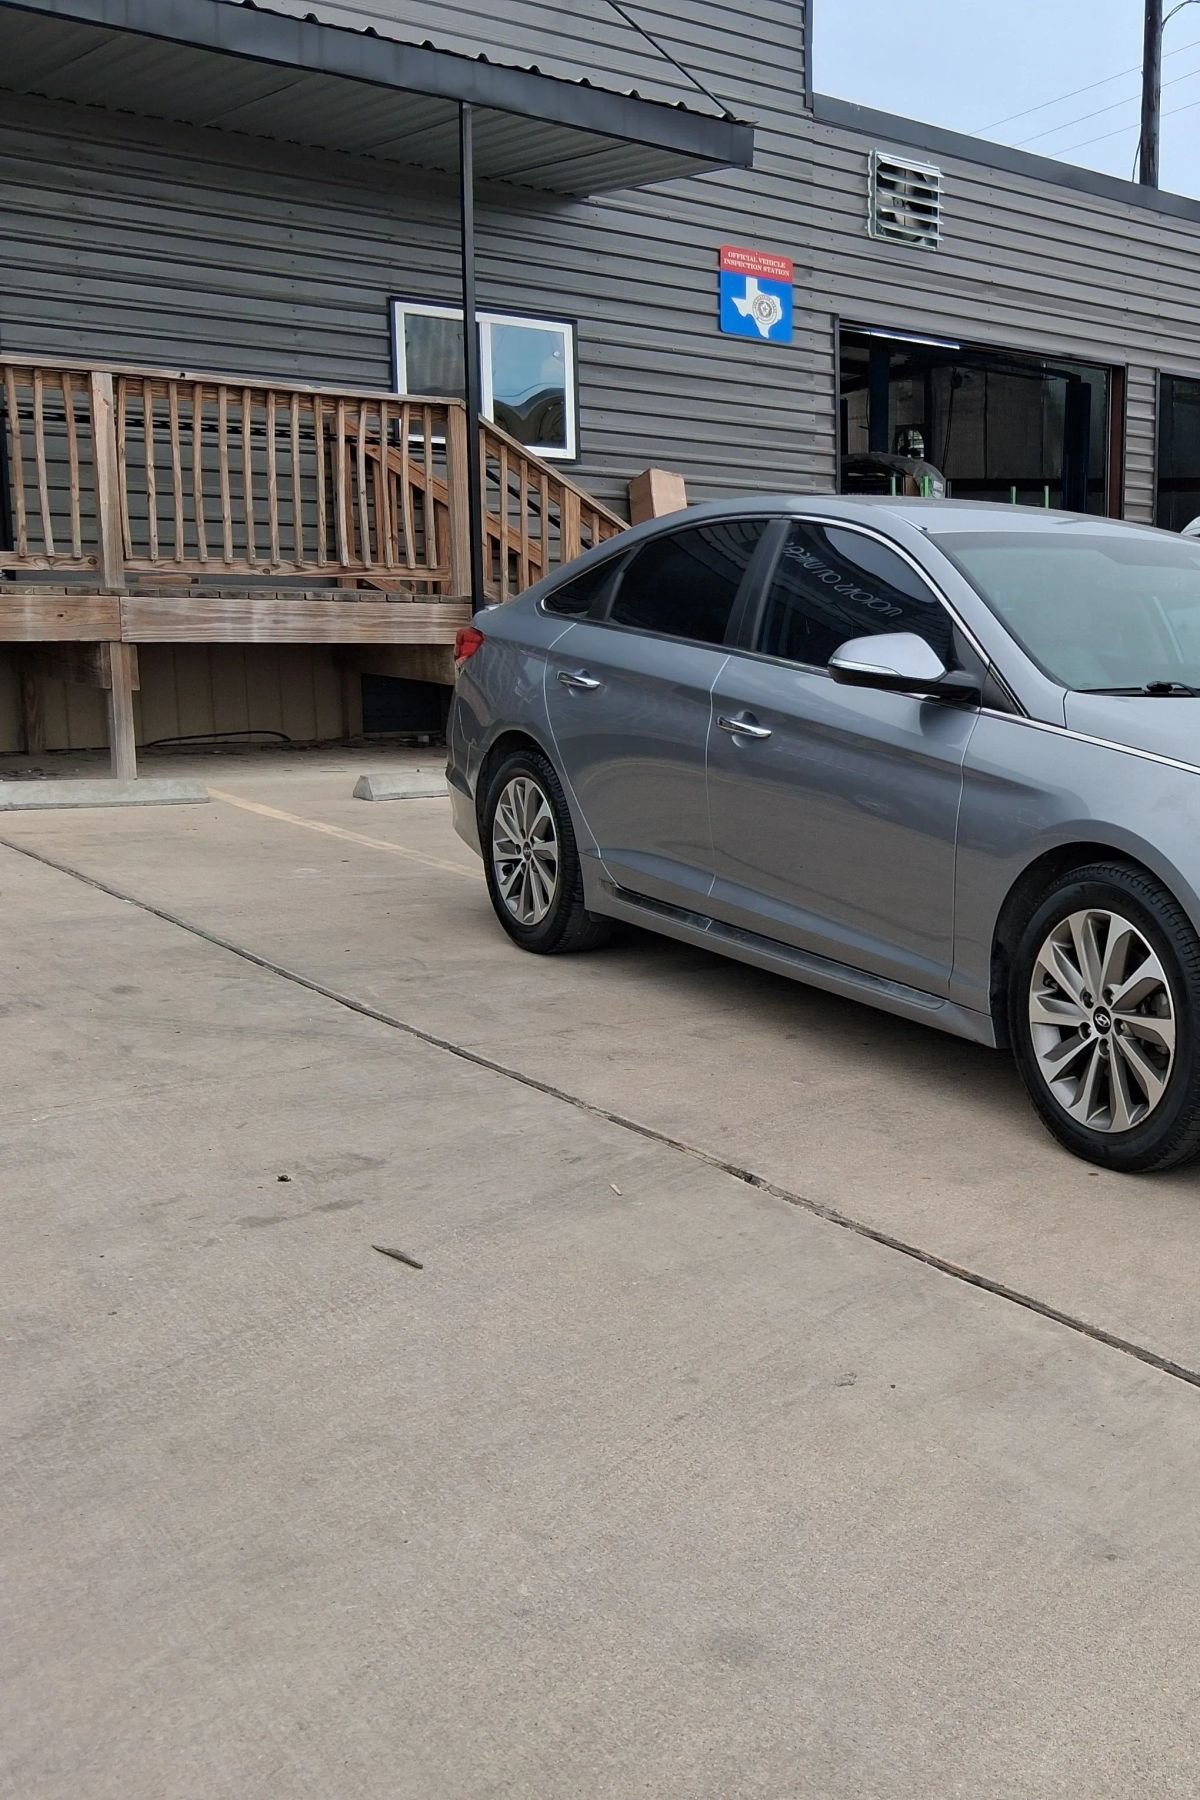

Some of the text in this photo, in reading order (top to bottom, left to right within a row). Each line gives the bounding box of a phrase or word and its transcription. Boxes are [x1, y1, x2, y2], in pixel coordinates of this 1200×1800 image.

[724, 258, 790, 277] INSPECTION STATION
[728, 251, 786, 269] OFFICIAL VEHICLE
